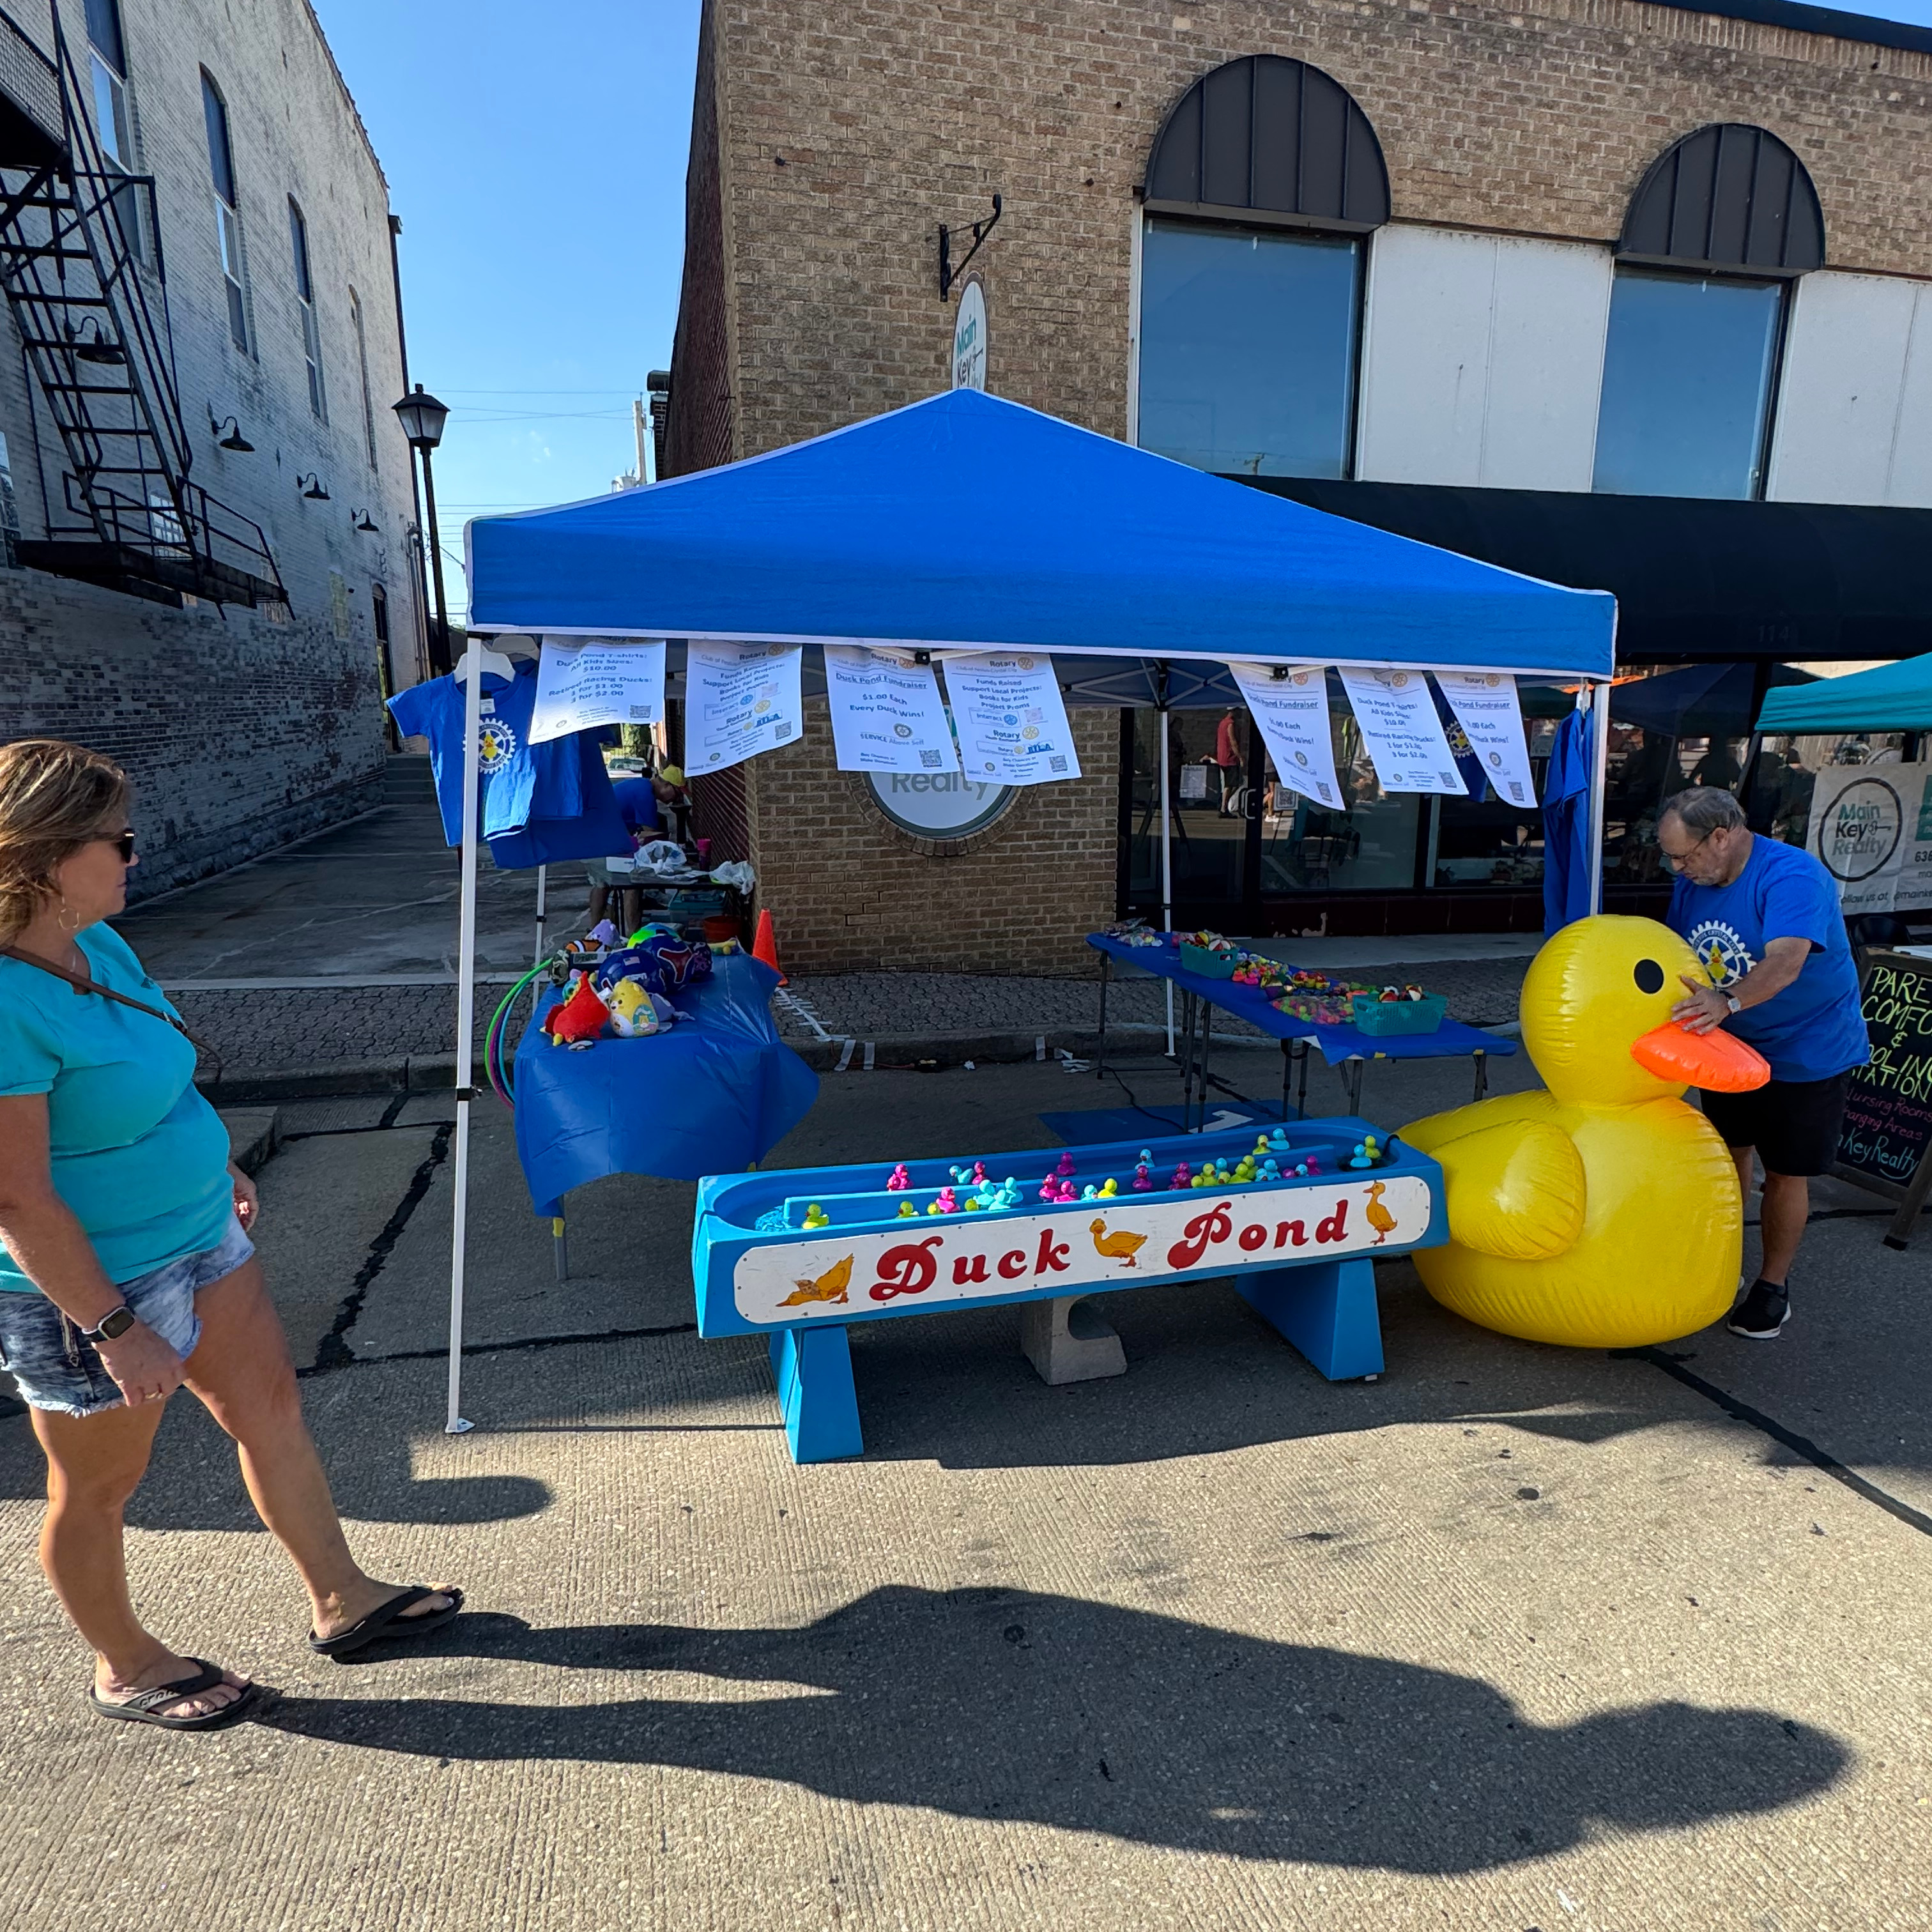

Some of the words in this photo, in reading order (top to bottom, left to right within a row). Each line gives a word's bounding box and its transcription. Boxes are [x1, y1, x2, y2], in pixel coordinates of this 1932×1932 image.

[957, 313, 976, 359] Main
[958, 354, 972, 388] Key
[1758, 625, 1788, 642] 114
[739, 651, 767, 661] Rotary
[871, 653, 898, 665] Rotary
[703, 679, 733, 688] Support
[735, 673, 753, 684] Local
[720, 670, 742, 679] Funds
[836, 673, 857, 683] Duck
[860, 675, 882, 684] Pond
[884, 675, 927, 689] Fundraiser
[549, 681, 582, 696] Retired
[719, 685, 742, 694] Books
[720, 689, 745, 702] Project
[889, 694, 907, 705] Each
[981, 702, 1006, 710] Project
[1279, 700, 1319, 709] Fundraiser
[726, 709, 753, 724] Rotary
[877, 705, 898, 716] Duck
[898, 710, 925, 718] Wins!
[976, 713, 1003, 722] Interact
[1285, 722, 1301, 730] Each
[1481, 721, 1496, 730] Each
[993, 730, 1020, 739] Rotary
[1295, 737, 1314, 745] Wins!
[1027, 743, 1052, 753] RYLA
[1838, 801, 1880, 820] Main
[1835, 822, 1869, 841] Key
[1832, 836, 1887, 859] Realty
[1840, 894, 1864, 905] ollow
[1877, 891, 1889, 901] at
[1890, 1031, 1908, 1048] &
[1851, 1062, 1932, 1103] TATION
[1893, 1096, 1932, 1123] Rooms
[1843, 1105, 1883, 1132] hanging
[1884, 1116, 1924, 1141] Areas
[1843, 1126, 1873, 1163] Key
[1870, 1135, 1920, 1179] Realty
[869, 1228, 1071, 1301] Duck
[1167, 1199, 1349, 1270] Pond
